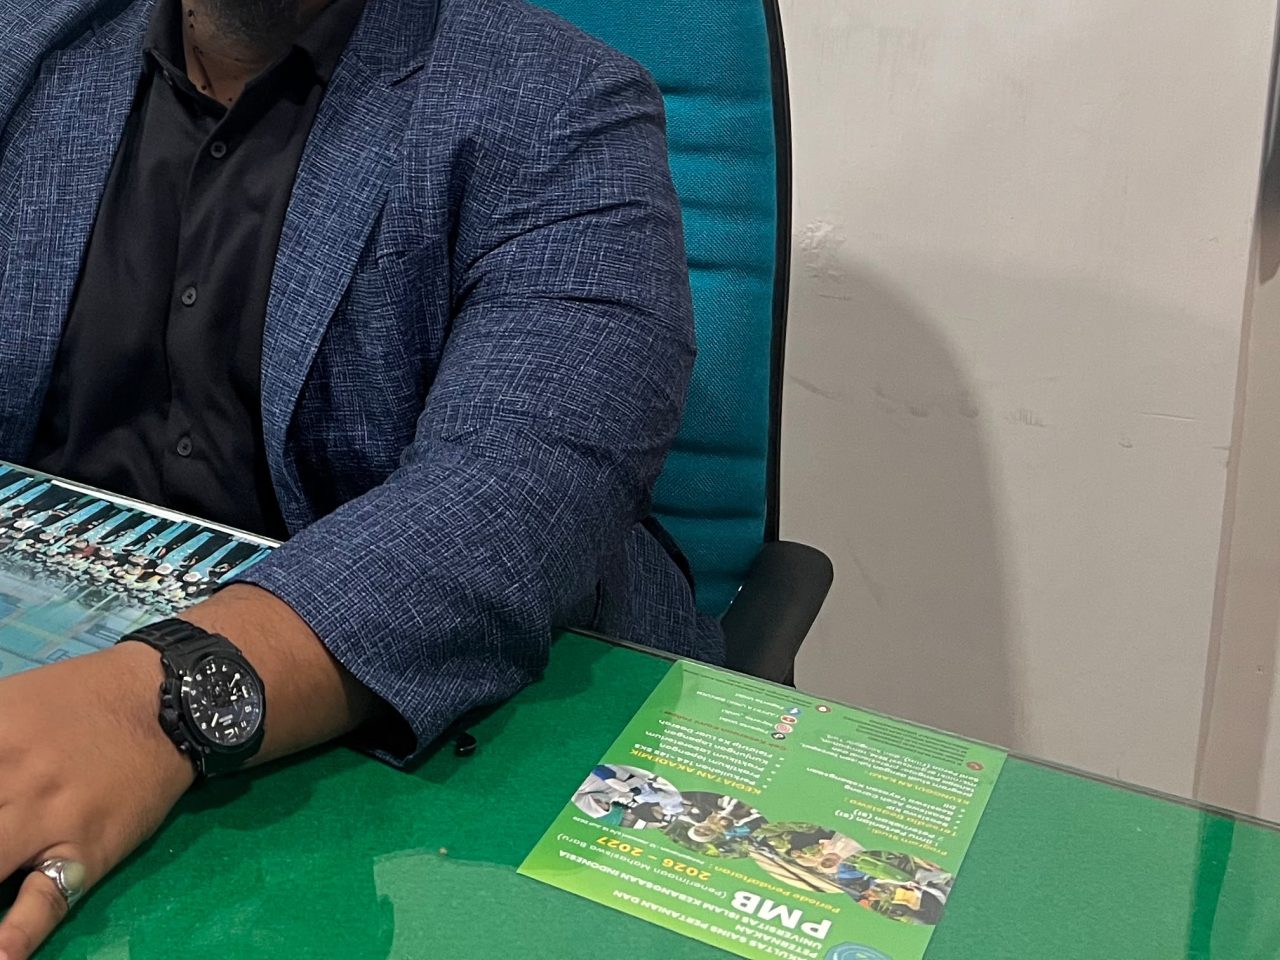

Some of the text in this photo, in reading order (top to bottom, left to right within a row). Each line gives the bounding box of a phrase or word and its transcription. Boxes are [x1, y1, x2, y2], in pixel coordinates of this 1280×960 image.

[643, 730, 765, 771] Praktikum Laboratorium
[711, 743, 770, 765] Kunjungan
[627, 748, 762, 794] KEGIATAN AKADEMIK
[693, 762, 756, 785] Perkuliahan
[706, 758, 761, 778] Praktikum
[854, 816, 907, 836] Pertanian
[555, 832, 588, 849] Baru)
[595, 834, 644, 857] 2027
[587, 844, 651, 870] Mahasiswa
[660, 857, 712, 881] 2026
[650, 866, 728, 899] (Penerimaan
[712, 865, 791, 896] Pendaftaran
[556, 849, 822, 949] UNIVERSITAS ISLAM KEBANGSAAN INDONESIA
[612, 889, 640, 903] DAN
[790, 891, 841, 913] Periode
[639, 899, 709, 929] PERTANIAN
[726, 888, 832, 940] PMB
[708, 924, 748, 943] SAINS
[733, 923, 818, 958] PETERNAKAN
